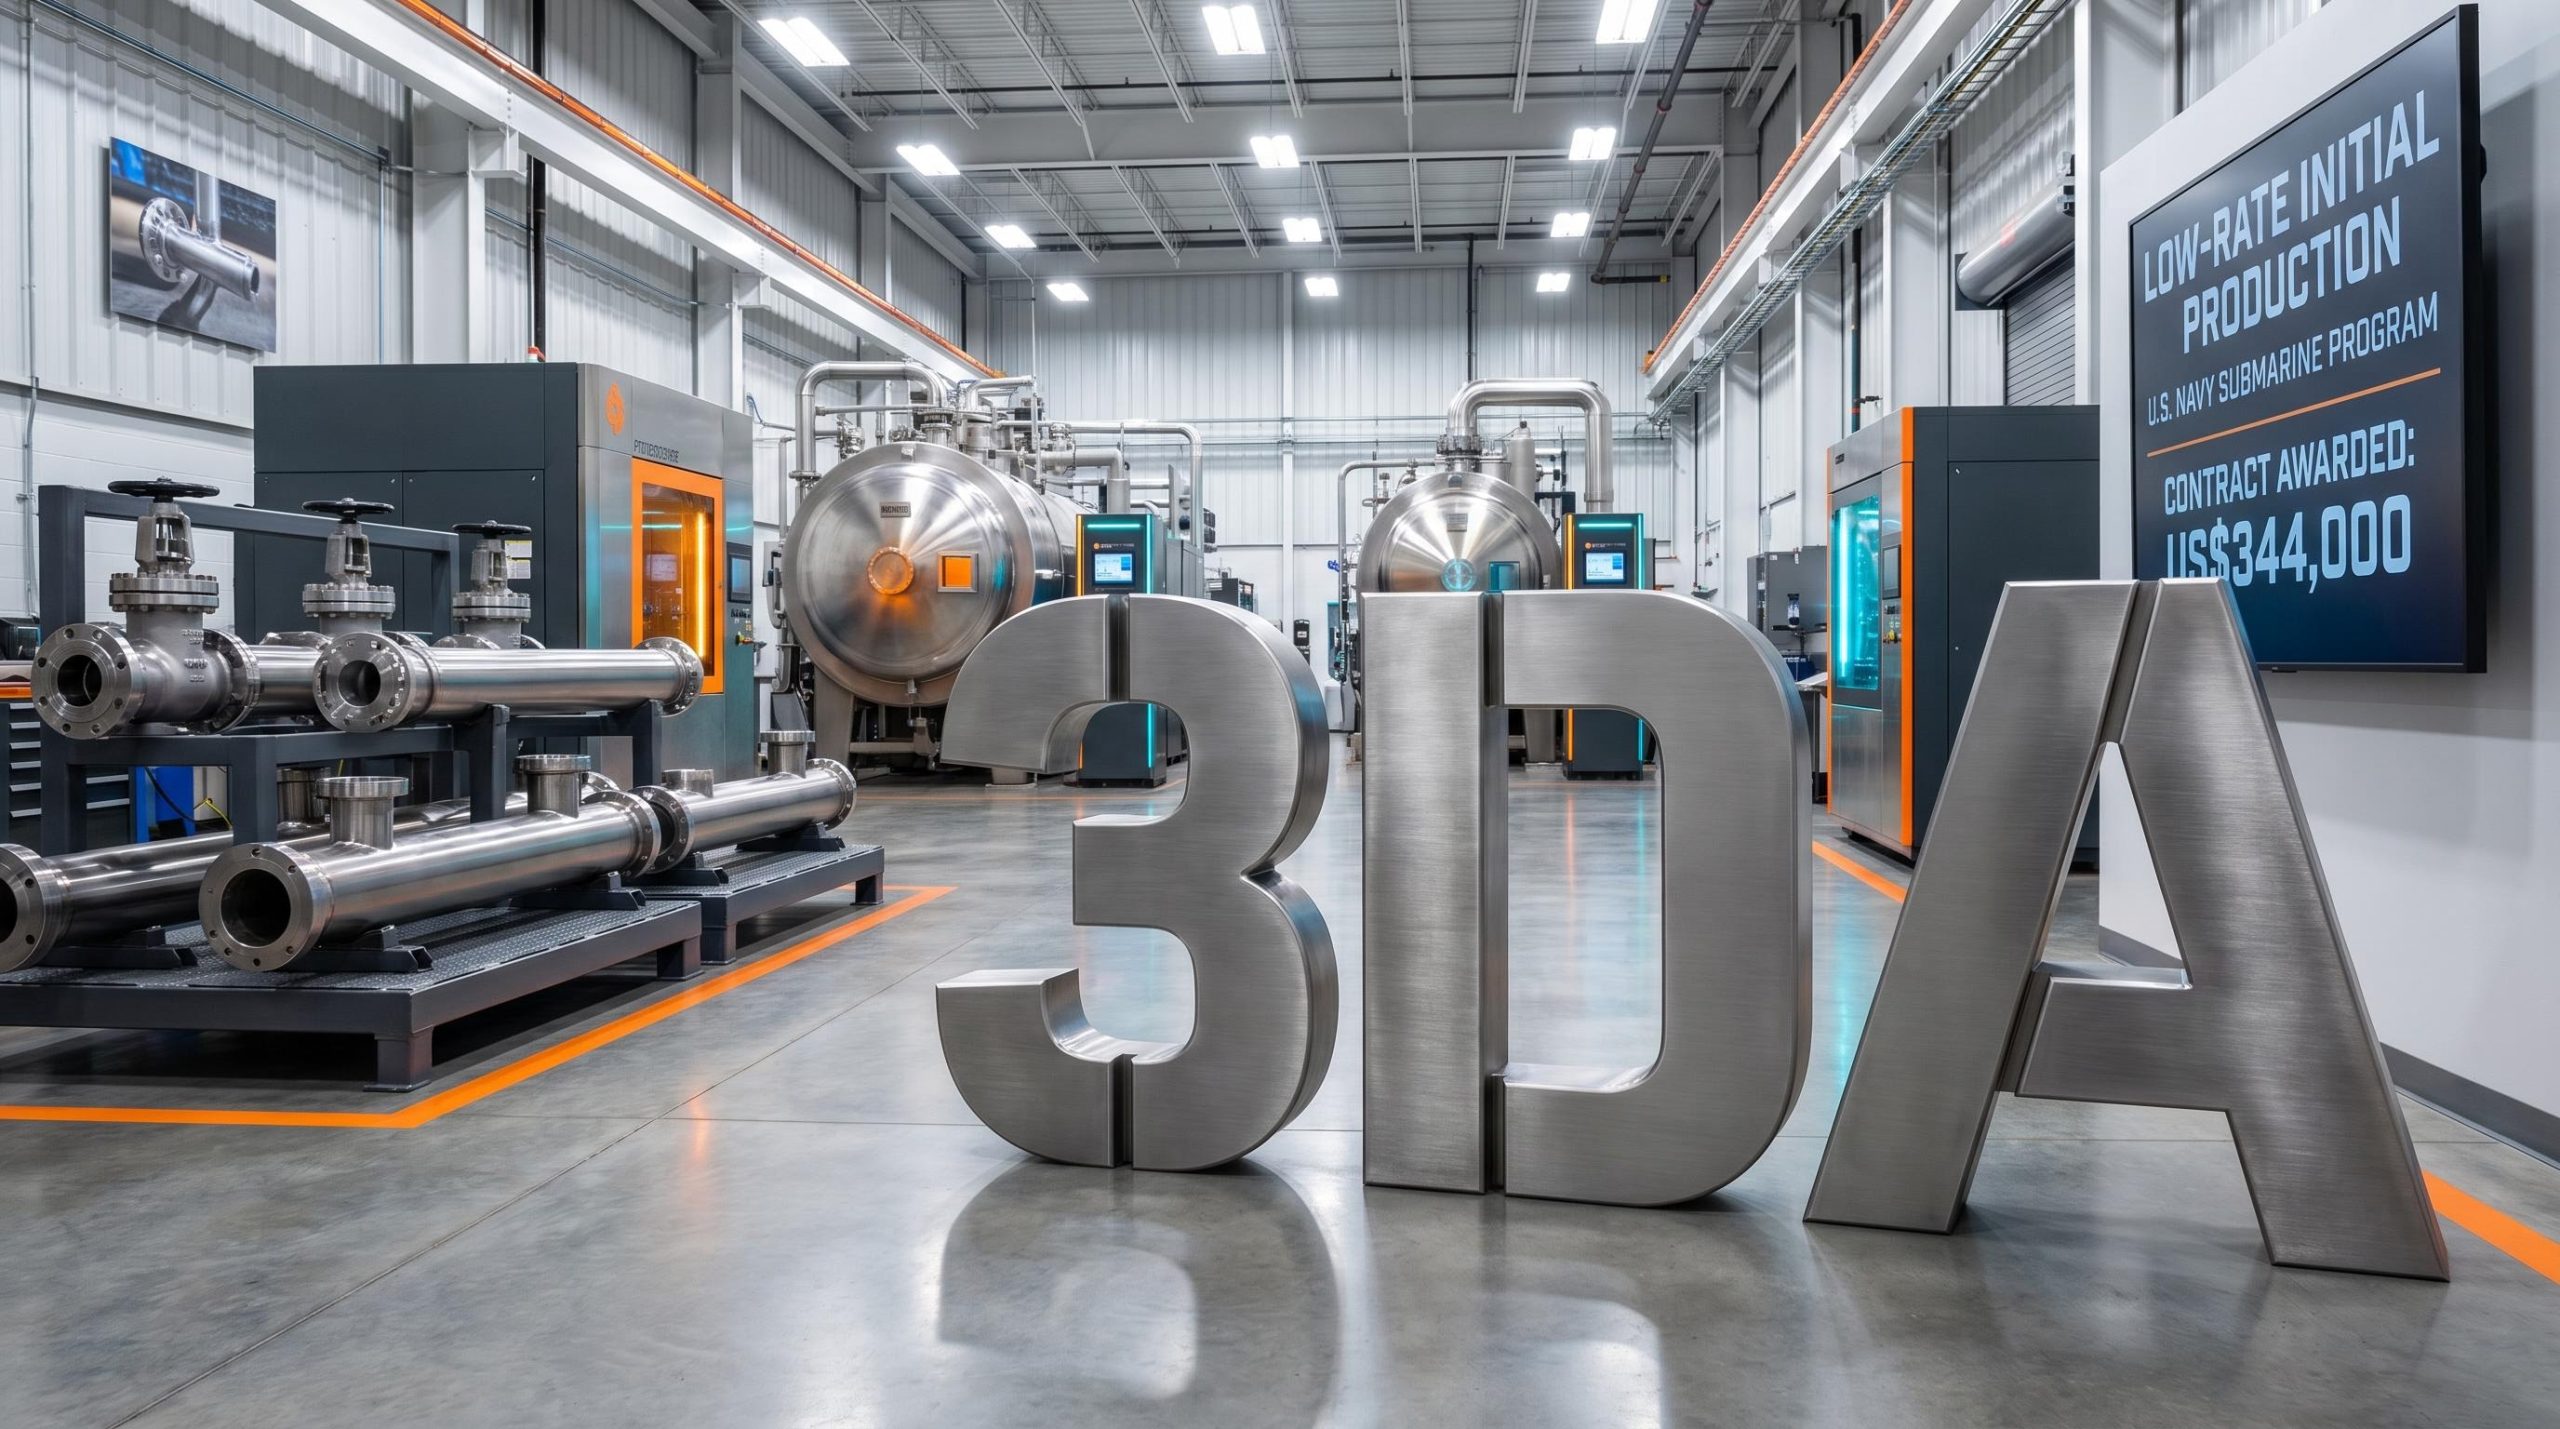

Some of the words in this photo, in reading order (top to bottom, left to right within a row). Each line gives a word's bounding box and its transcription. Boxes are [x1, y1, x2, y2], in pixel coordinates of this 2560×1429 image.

[2145, 169, 2290, 303] LOW-RATE
[2300, 90, 2440, 223] INITIAL
[2184, 196, 2400, 354] PRODUCTION
[2148, 394, 2172, 426] U.S.
[2176, 375, 2214, 416] NAVY
[2219, 335, 2323, 403] SUBMARINE
[2329, 291, 2438, 367] PROGRAM
[2165, 452, 2271, 515] CONTRACT
[2276, 419, 2415, 491] AWARDED:
[2168, 494, 2411, 593] US$344,000
[936, 579, 2450, 1281] 3DA
